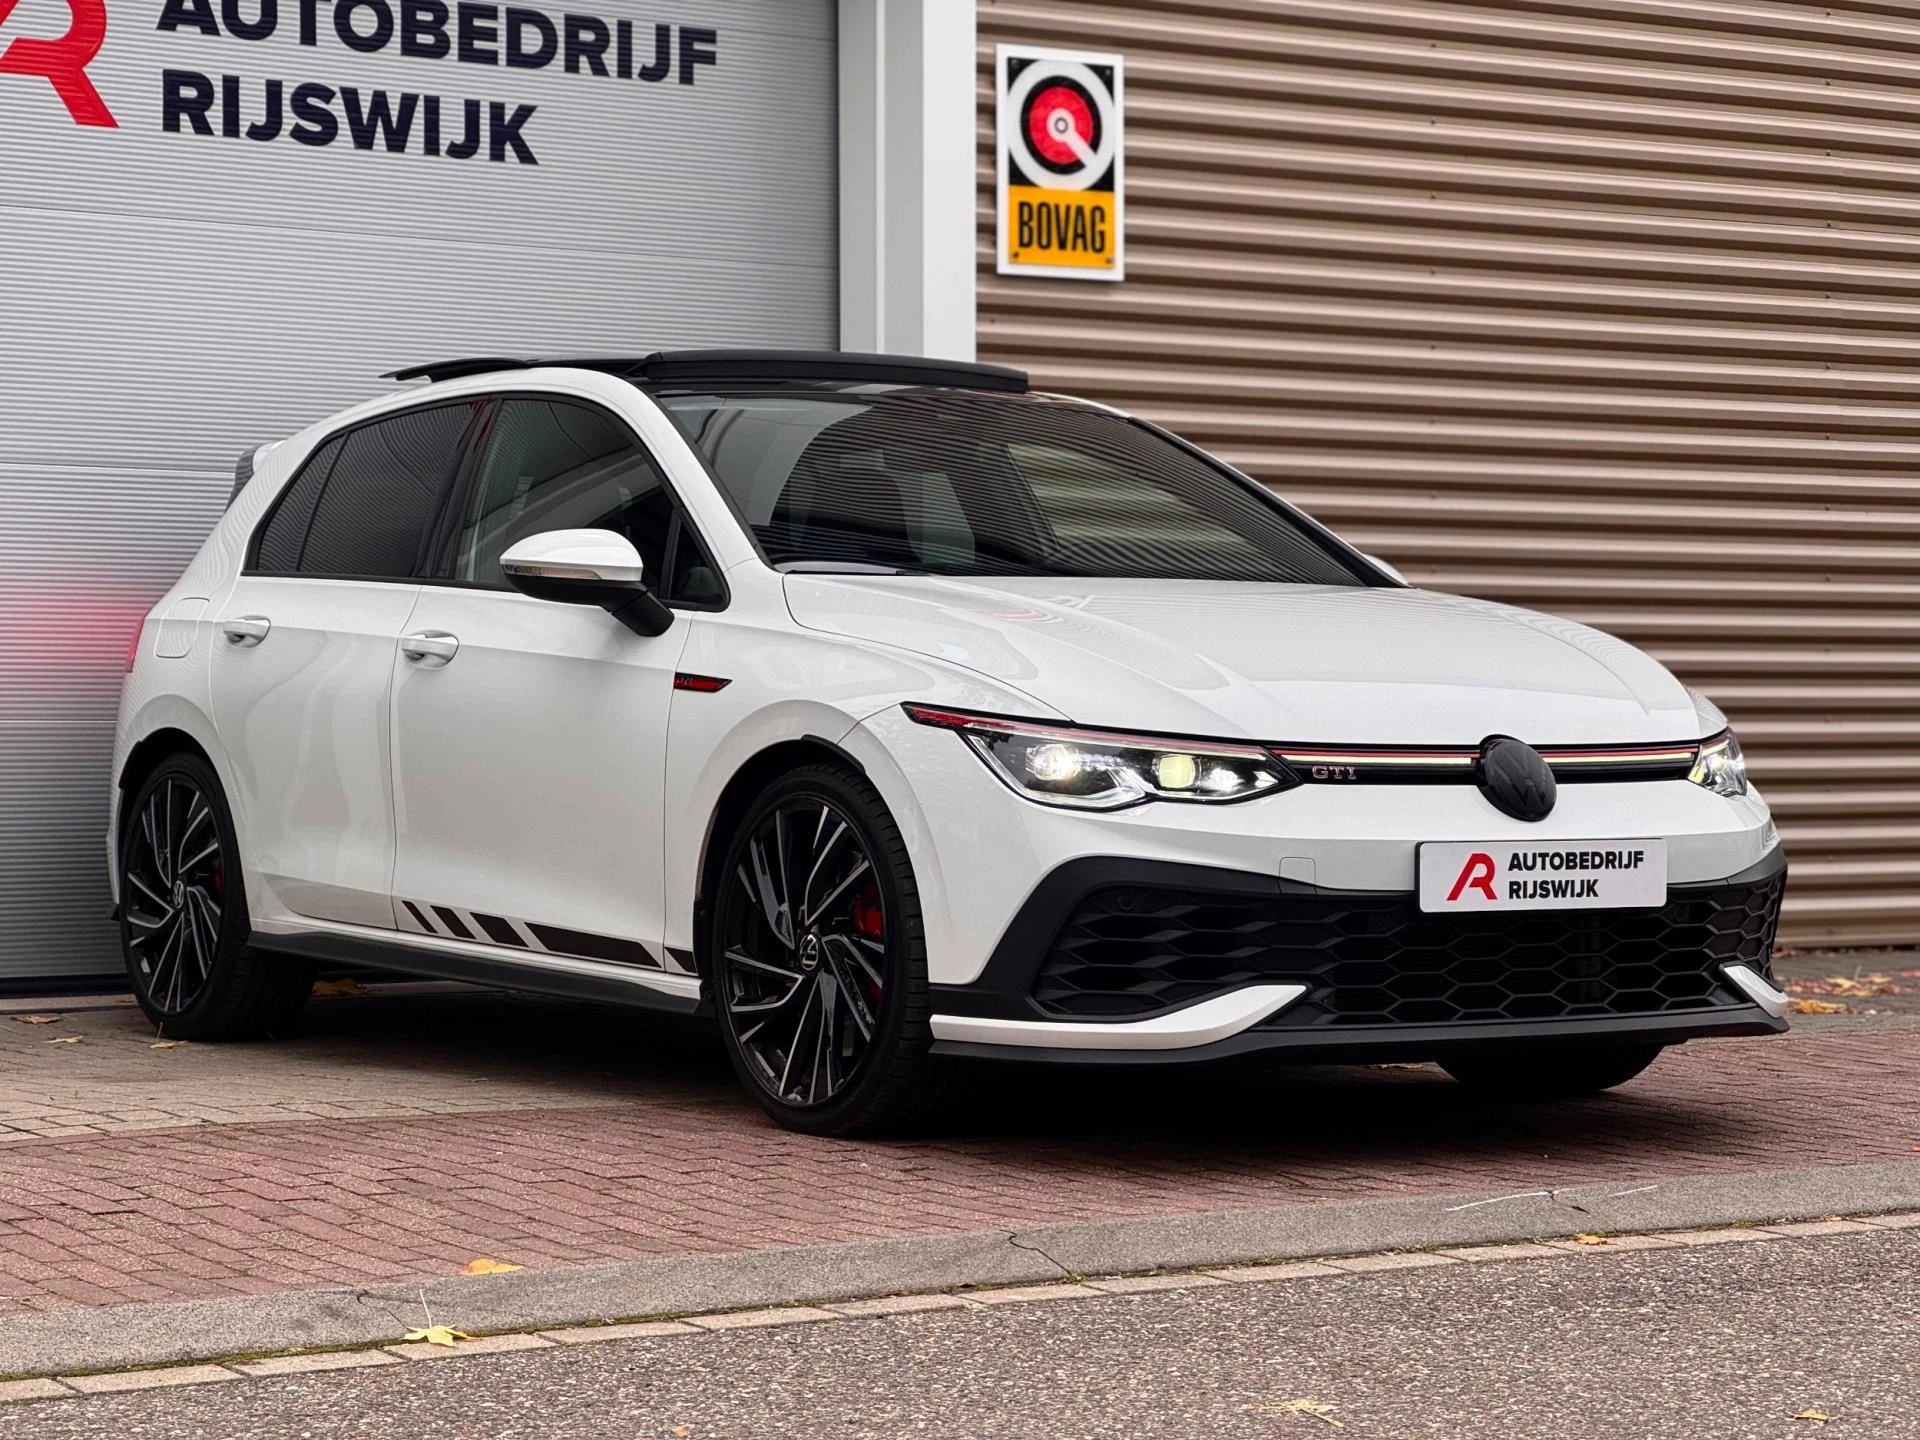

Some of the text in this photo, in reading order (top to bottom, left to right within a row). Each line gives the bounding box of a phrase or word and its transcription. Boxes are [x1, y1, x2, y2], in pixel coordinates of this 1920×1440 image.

[156, 0, 717, 86] AUTOBEDRIJF
[162, 69, 539, 166] RIJSWIJK
[1018, 201, 1106, 254] BOVAG
[1312, 765, 1357, 780] GTI
[1508, 851, 1644, 871] AUTOBEDRIJF
[1508, 879, 1599, 900] RIJSWIJK
